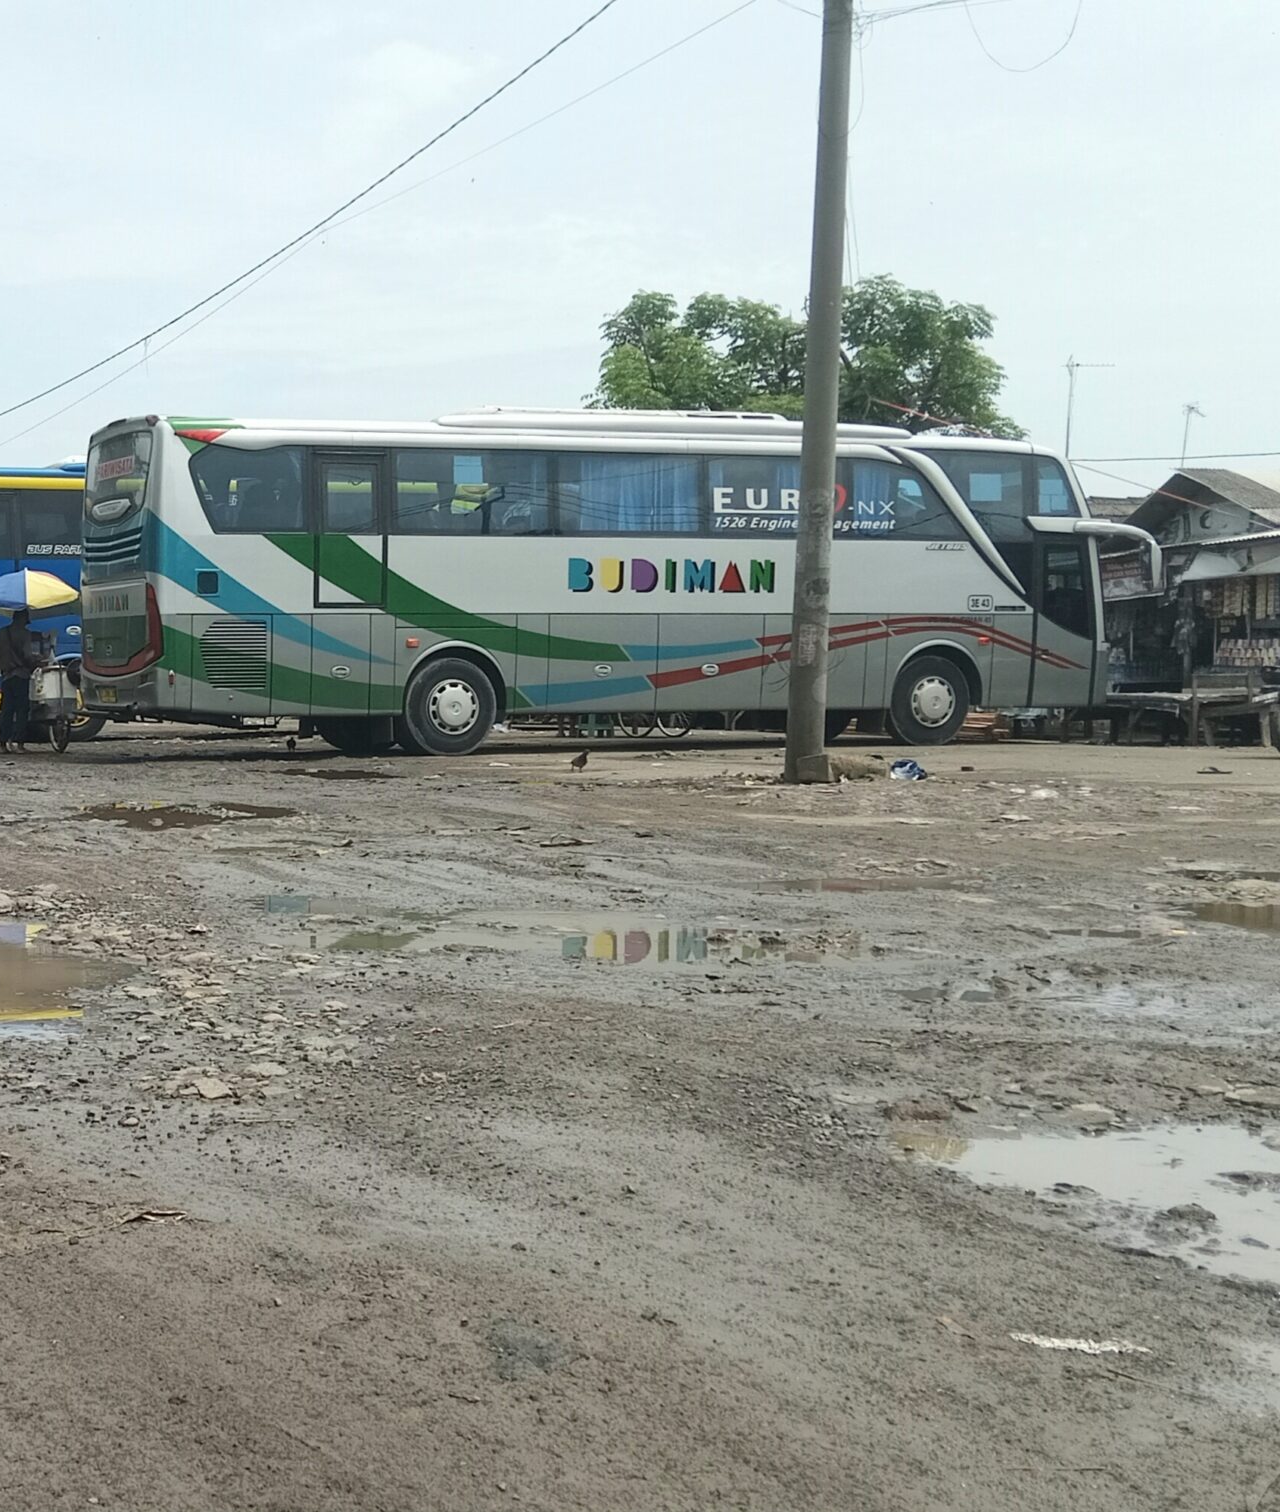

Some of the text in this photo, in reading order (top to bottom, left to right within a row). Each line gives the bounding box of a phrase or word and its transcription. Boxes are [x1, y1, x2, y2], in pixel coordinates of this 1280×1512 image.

[715, 517, 896, 532] 1526 Engine agement
[26, 544, 53, 555] BUS
[925, 543, 968, 552] JETBUS
[568, 557, 776, 593] BUDIMAN
[981, 598, 990, 608] 43
